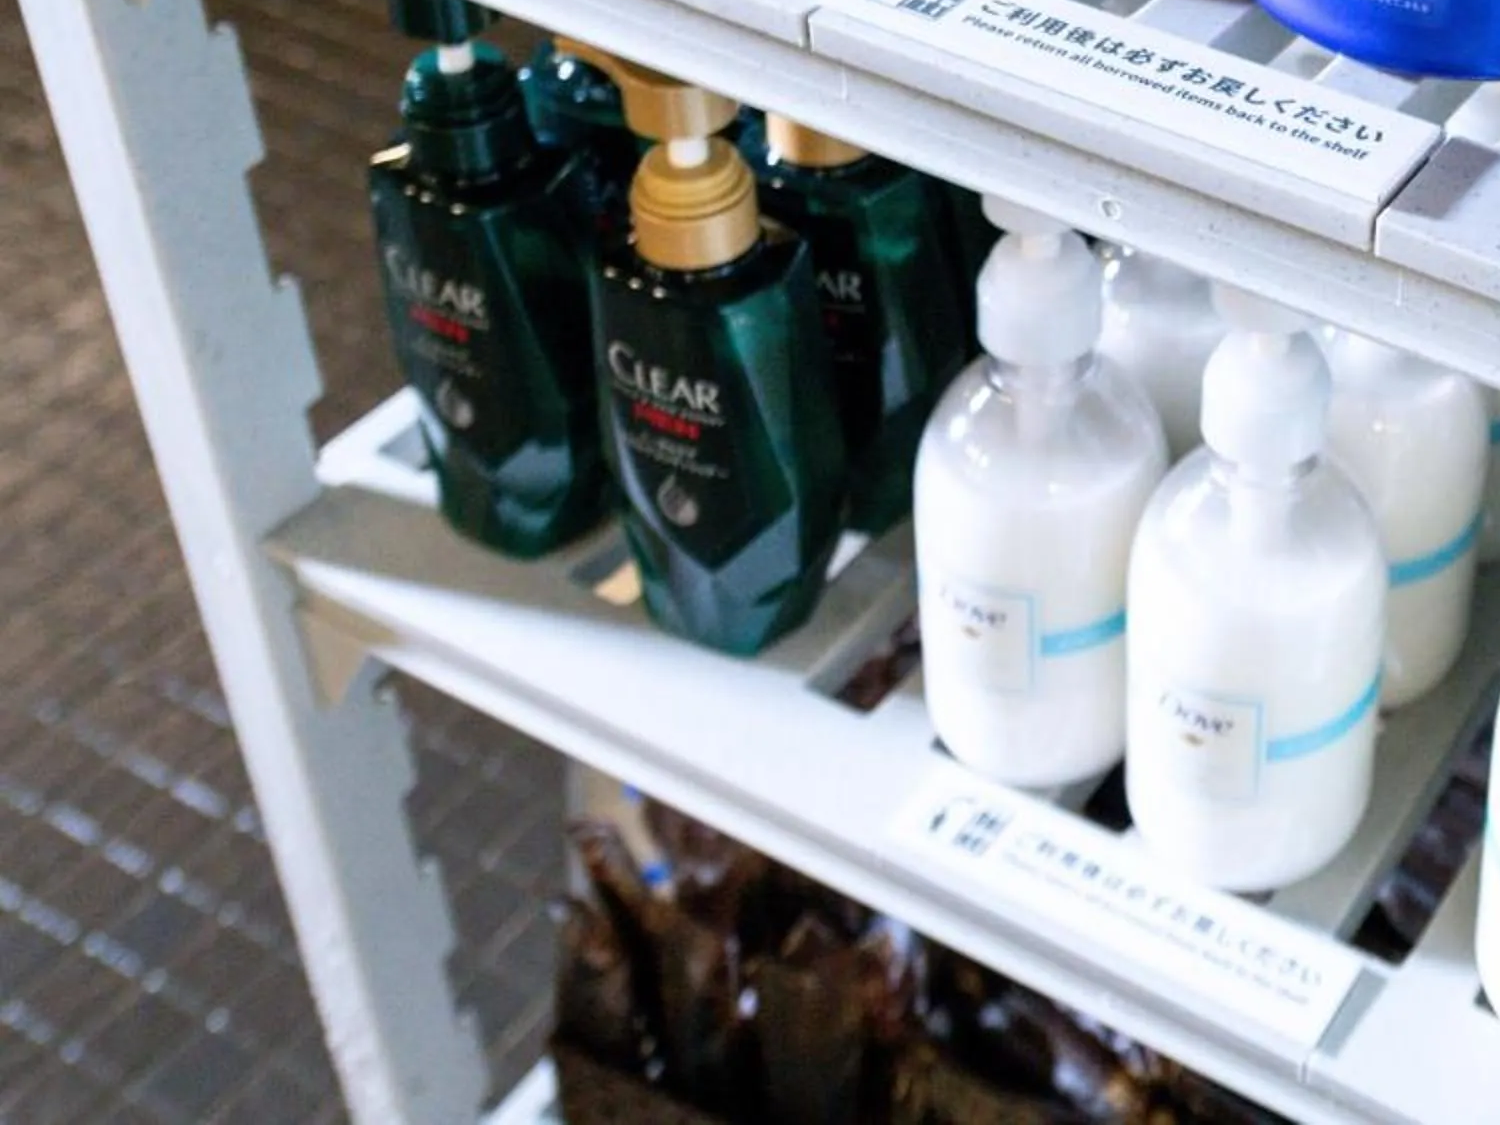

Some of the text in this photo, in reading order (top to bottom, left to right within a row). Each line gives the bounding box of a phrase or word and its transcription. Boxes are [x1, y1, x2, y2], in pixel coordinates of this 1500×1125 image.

[962, 13, 1370, 161] Please return all borrowed items back to the shelf
[981, 0, 1384, 143] ご利用後は必ずお戻しください
[608, 340, 720, 415] CLEAR
